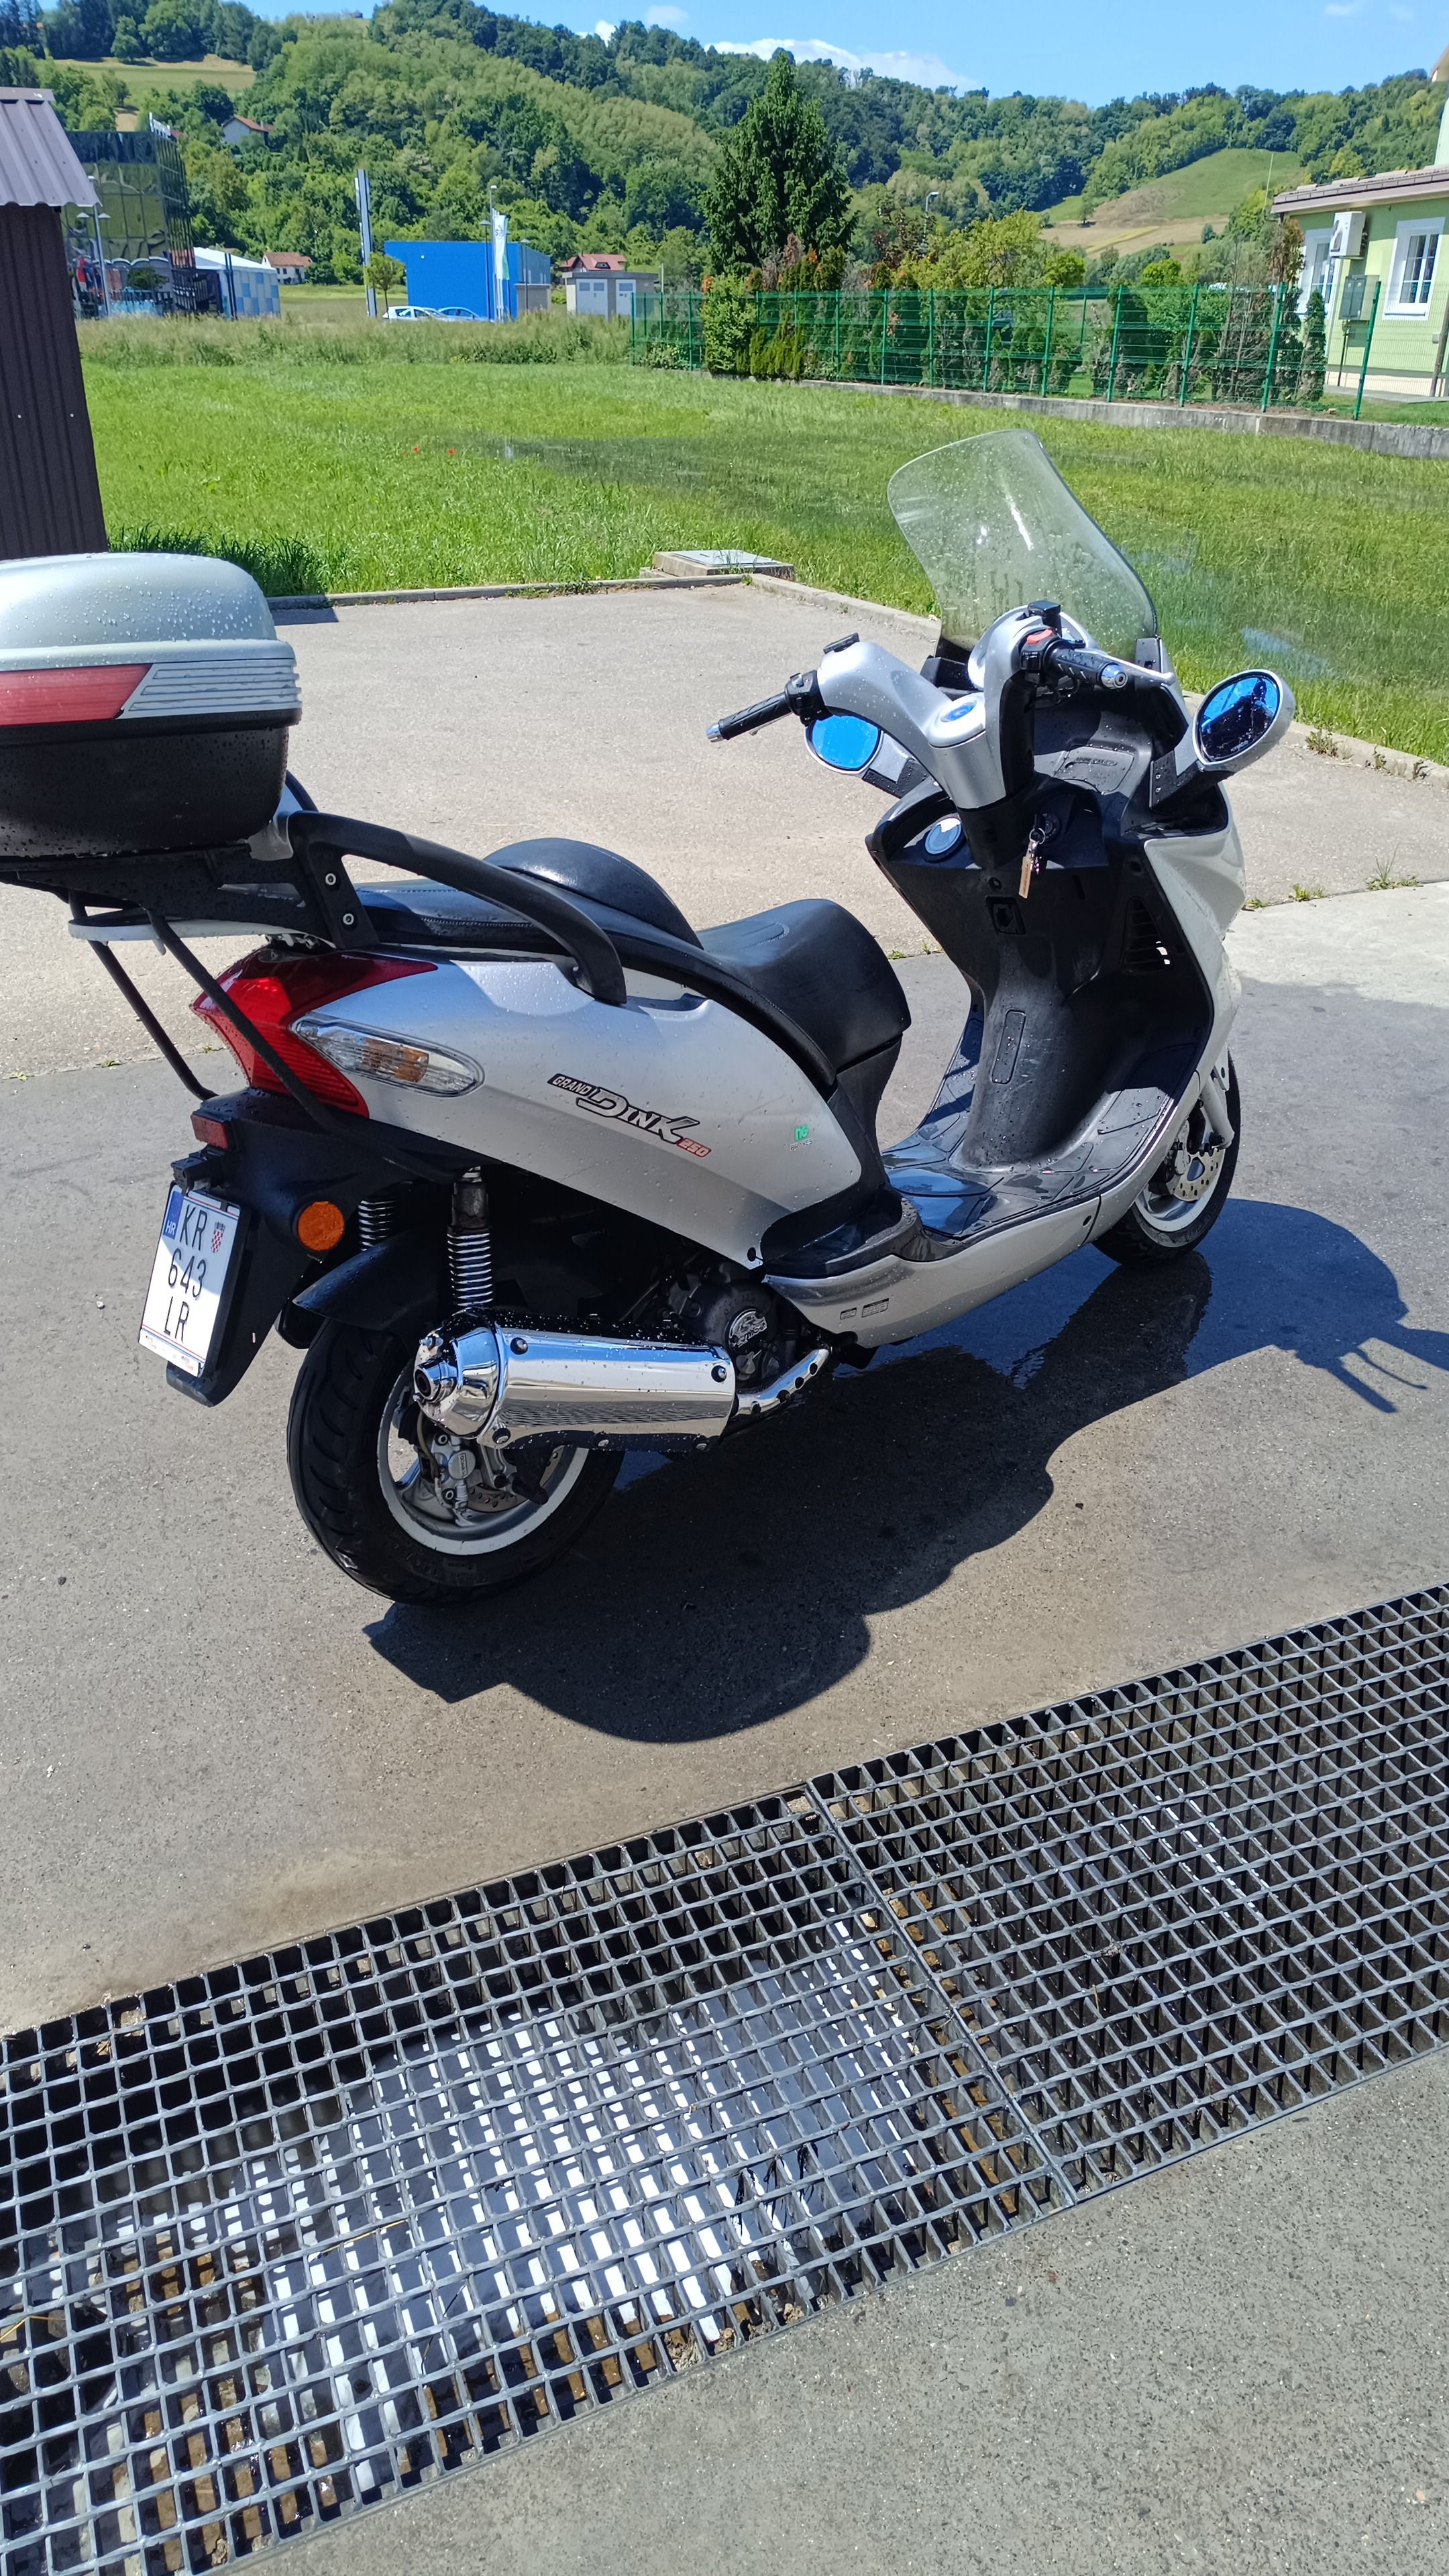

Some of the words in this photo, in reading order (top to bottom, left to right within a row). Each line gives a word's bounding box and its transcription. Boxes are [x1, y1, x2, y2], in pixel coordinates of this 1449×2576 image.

[551, 1075, 591, 1096] GRAND
[679, 1139, 710, 1157] 250
[166, 1220, 176, 1236] HR
[180, 1204, 207, 1250] KR
[168, 1248, 207, 1299] 643
[164, 1296, 189, 1342] LR
